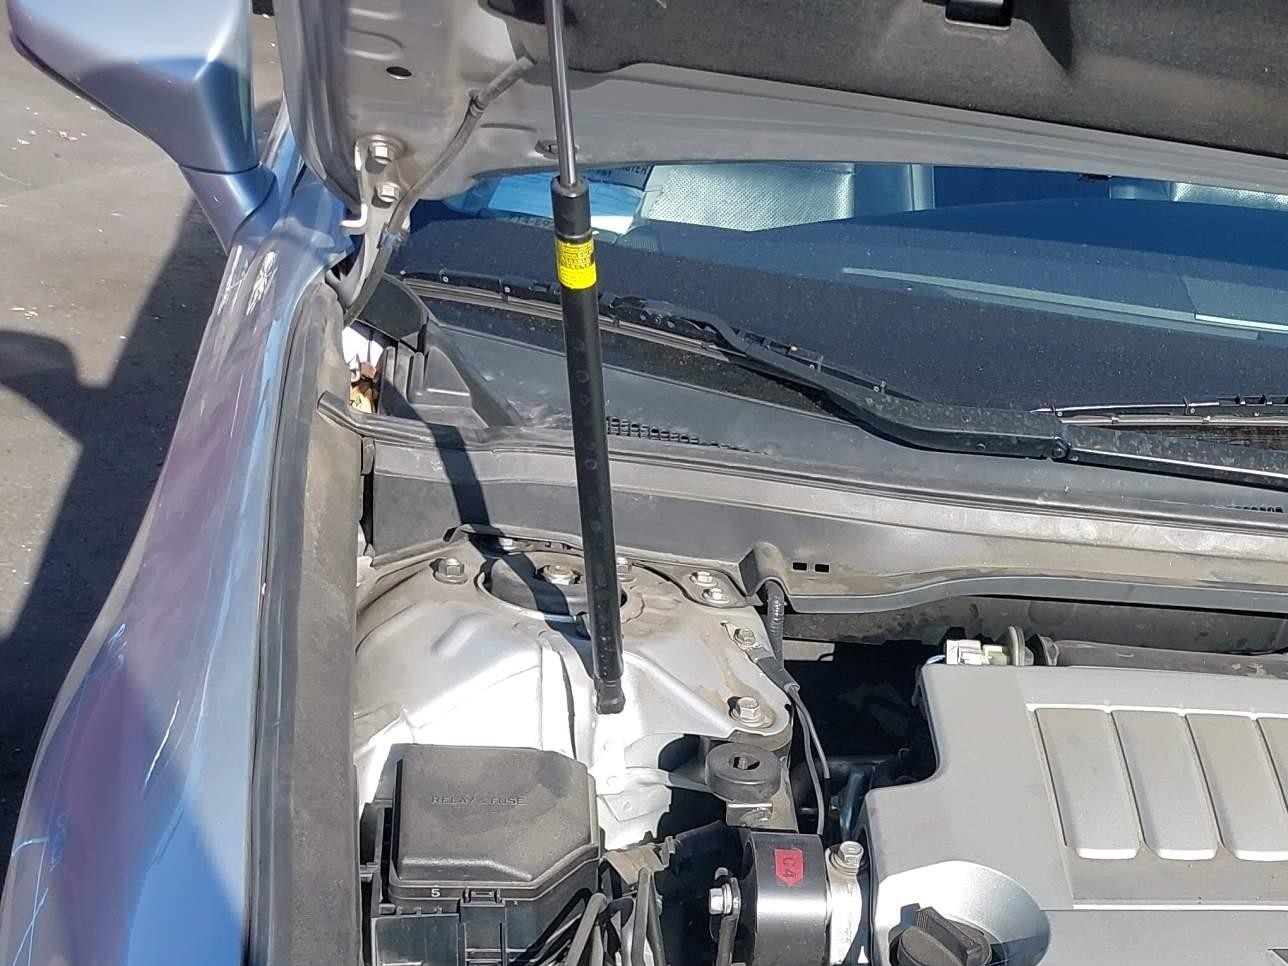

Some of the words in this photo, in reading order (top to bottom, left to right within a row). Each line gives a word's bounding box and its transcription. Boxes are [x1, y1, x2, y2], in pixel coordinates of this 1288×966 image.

[431, 794, 476, 805] RELAY
[490, 797, 526, 806] FUSE
[431, 888, 440, 897] 5
